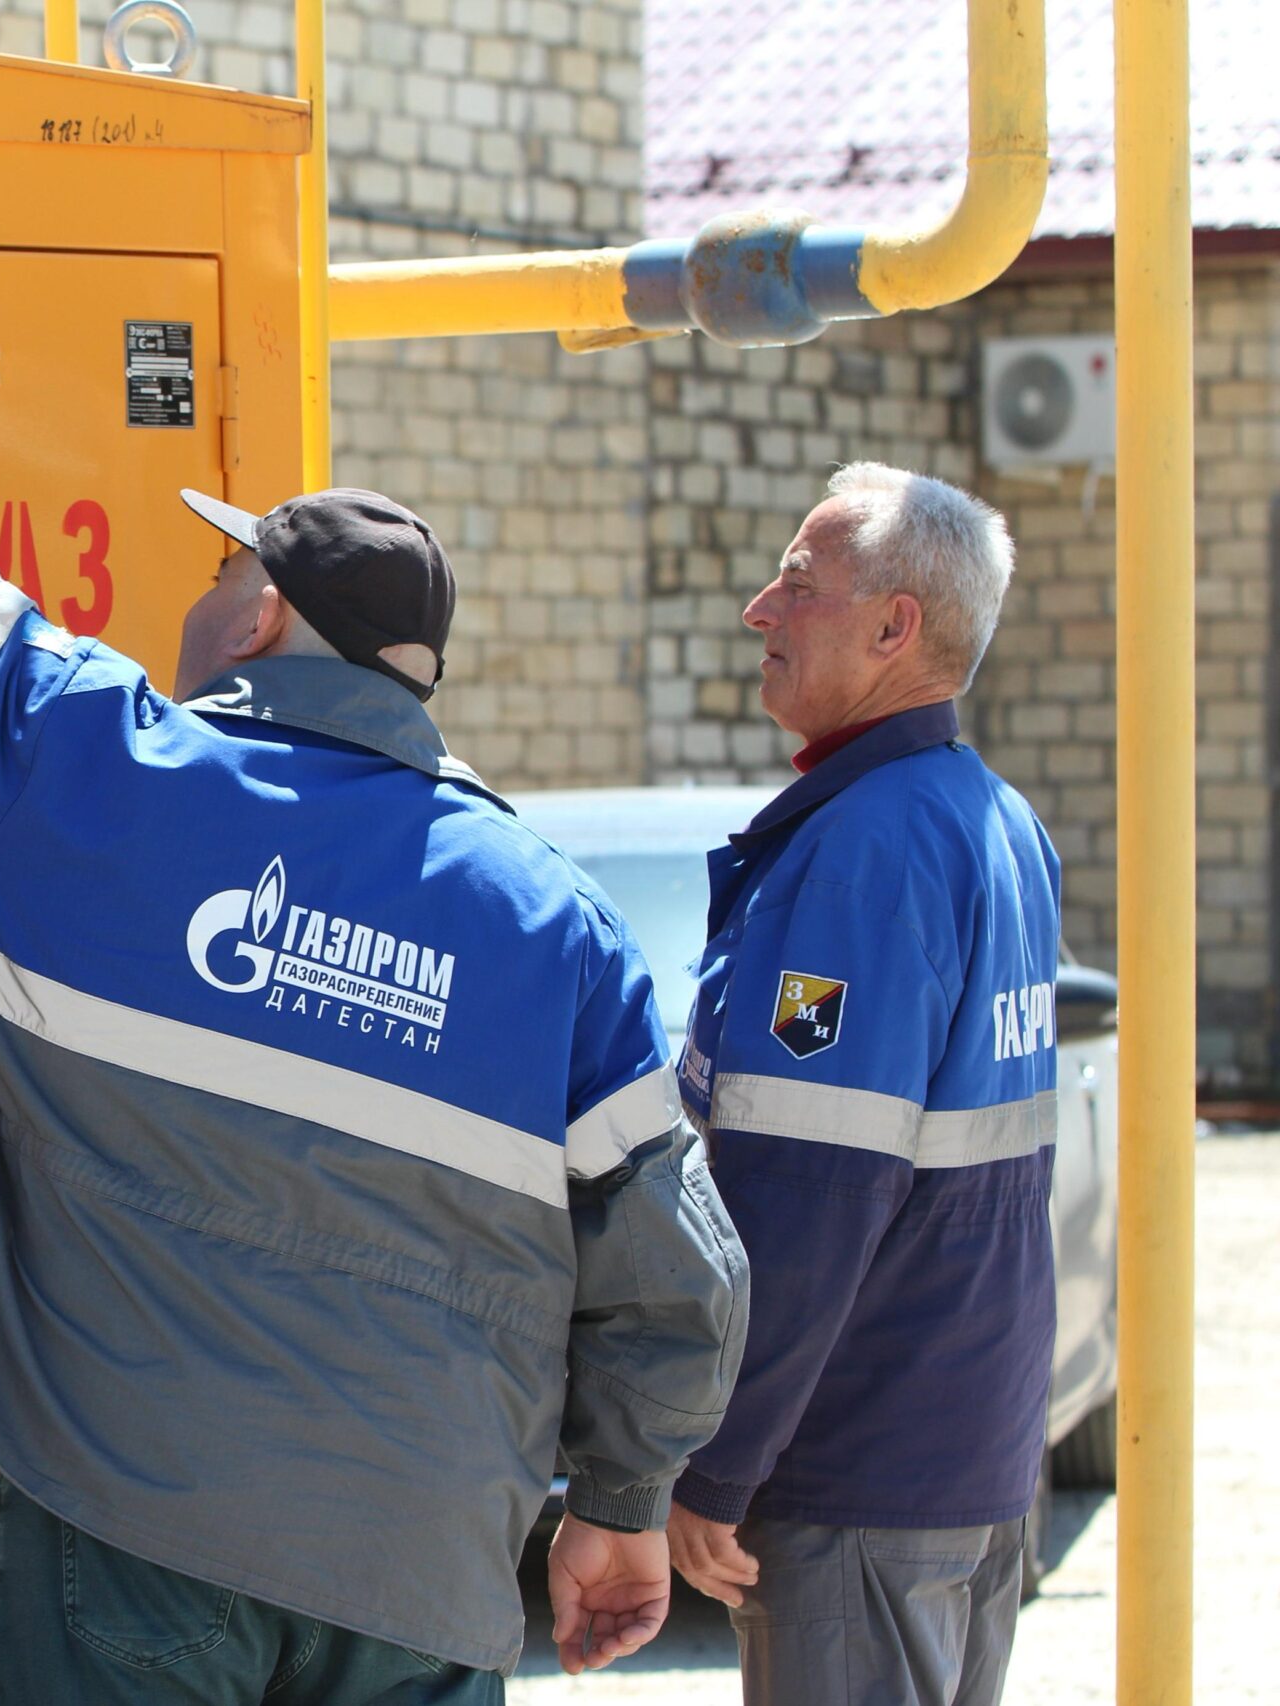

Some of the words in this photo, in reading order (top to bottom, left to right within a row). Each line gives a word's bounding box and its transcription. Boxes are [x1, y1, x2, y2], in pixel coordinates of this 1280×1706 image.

[281, 904, 456, 1000] ГАЗПРОМ
[265, 985, 441, 1055] ДАГЕСТАН
[279, 960, 443, 1024] ГАЗОРАСПРЕДЕЛЕНИЕ
